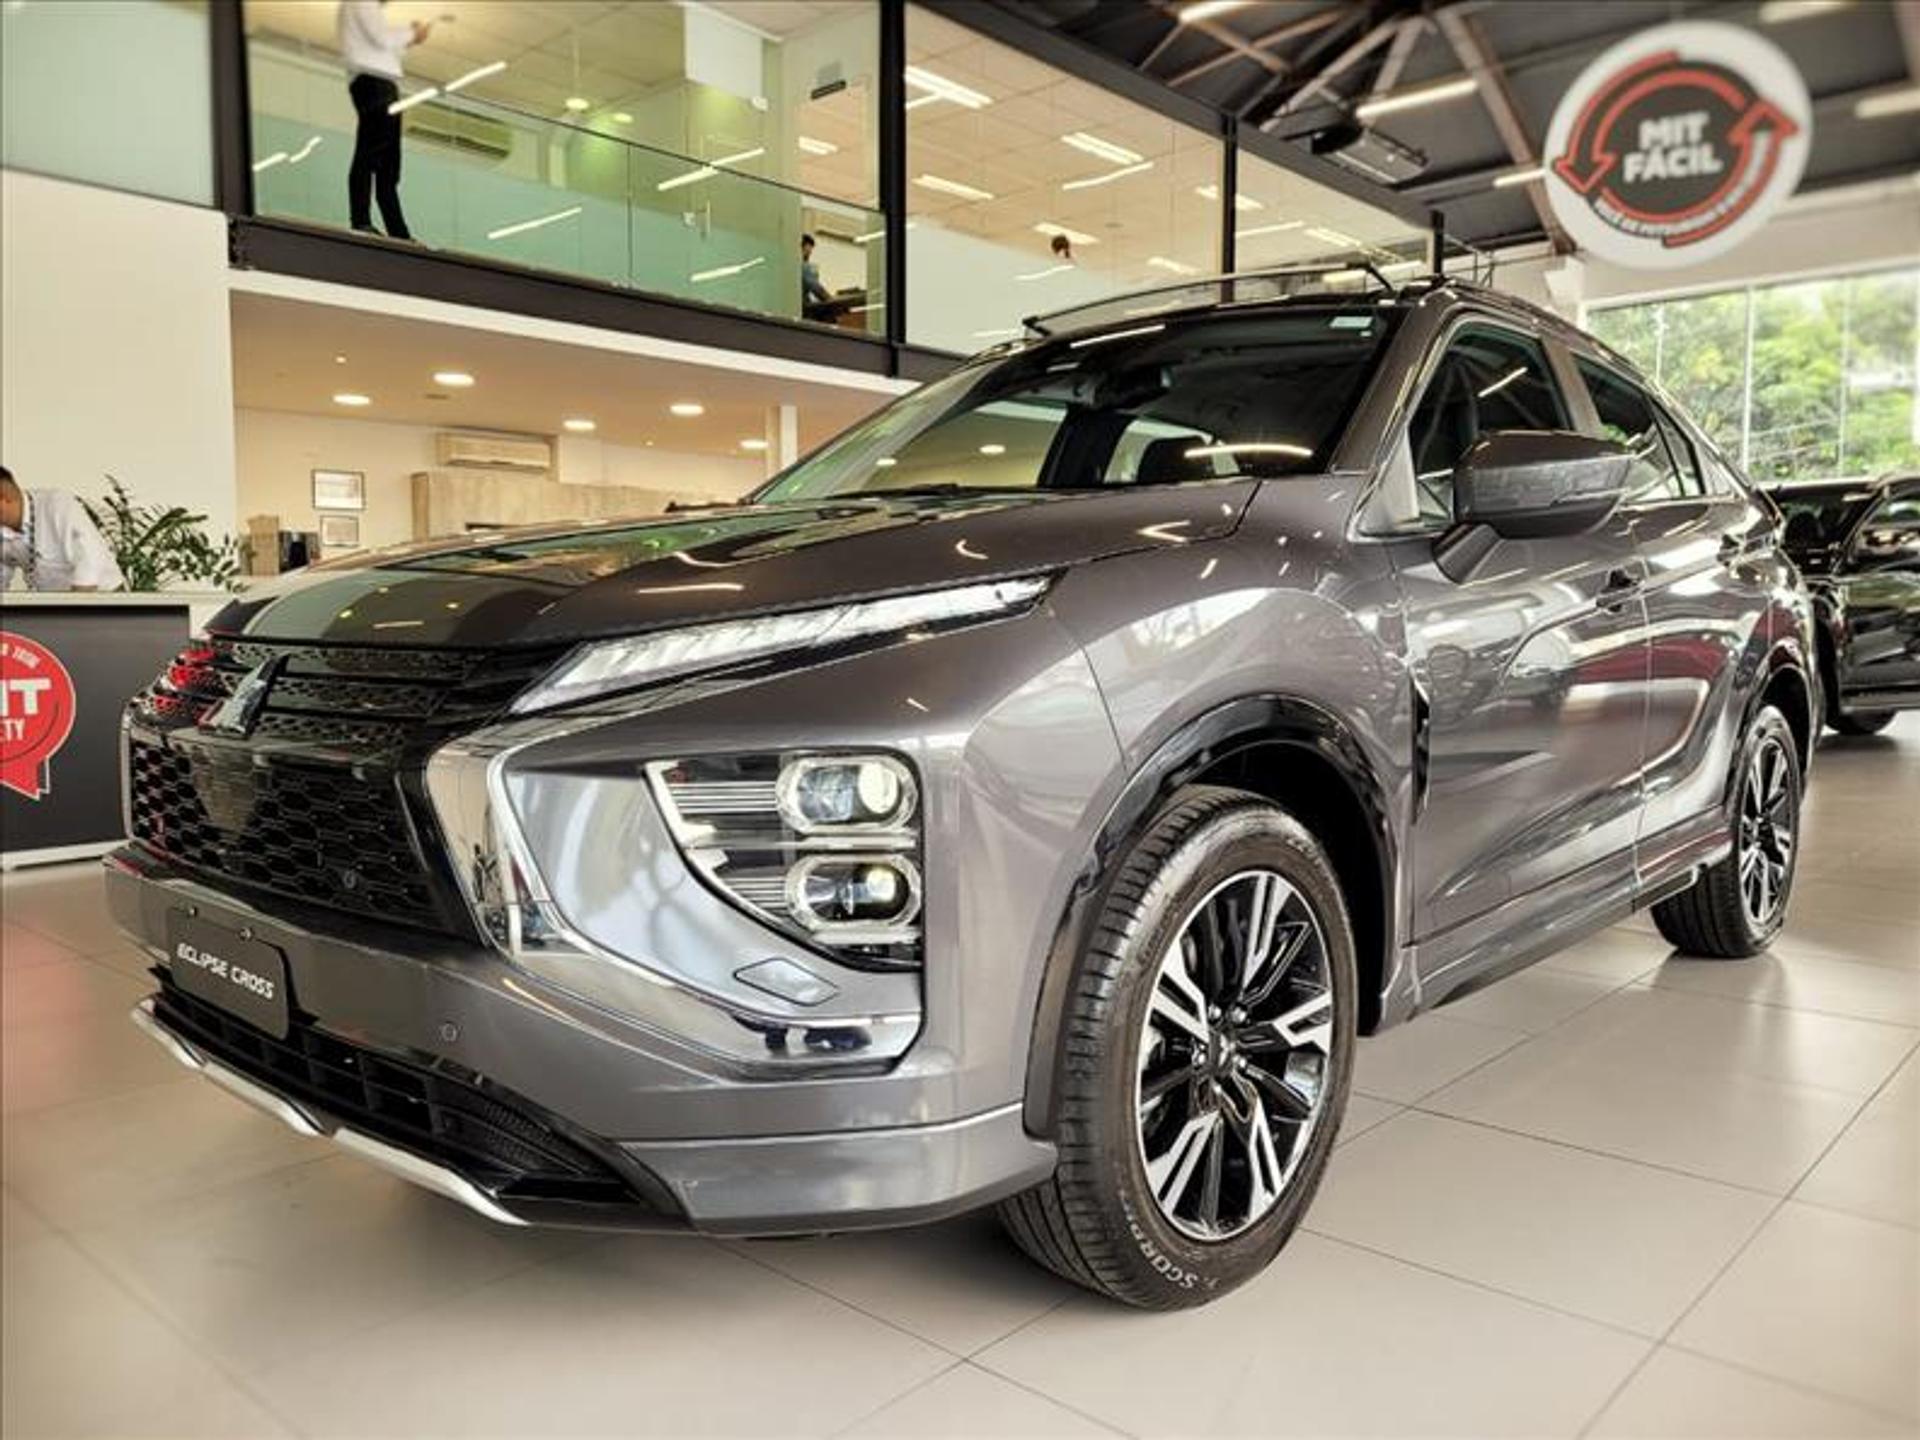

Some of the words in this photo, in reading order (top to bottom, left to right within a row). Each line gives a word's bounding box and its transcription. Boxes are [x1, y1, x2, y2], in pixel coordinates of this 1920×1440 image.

[1639, 111, 1709, 150] MIT
[177, 943, 228, 978] ECLIPSE
[230, 966, 274, 999] CROSS
